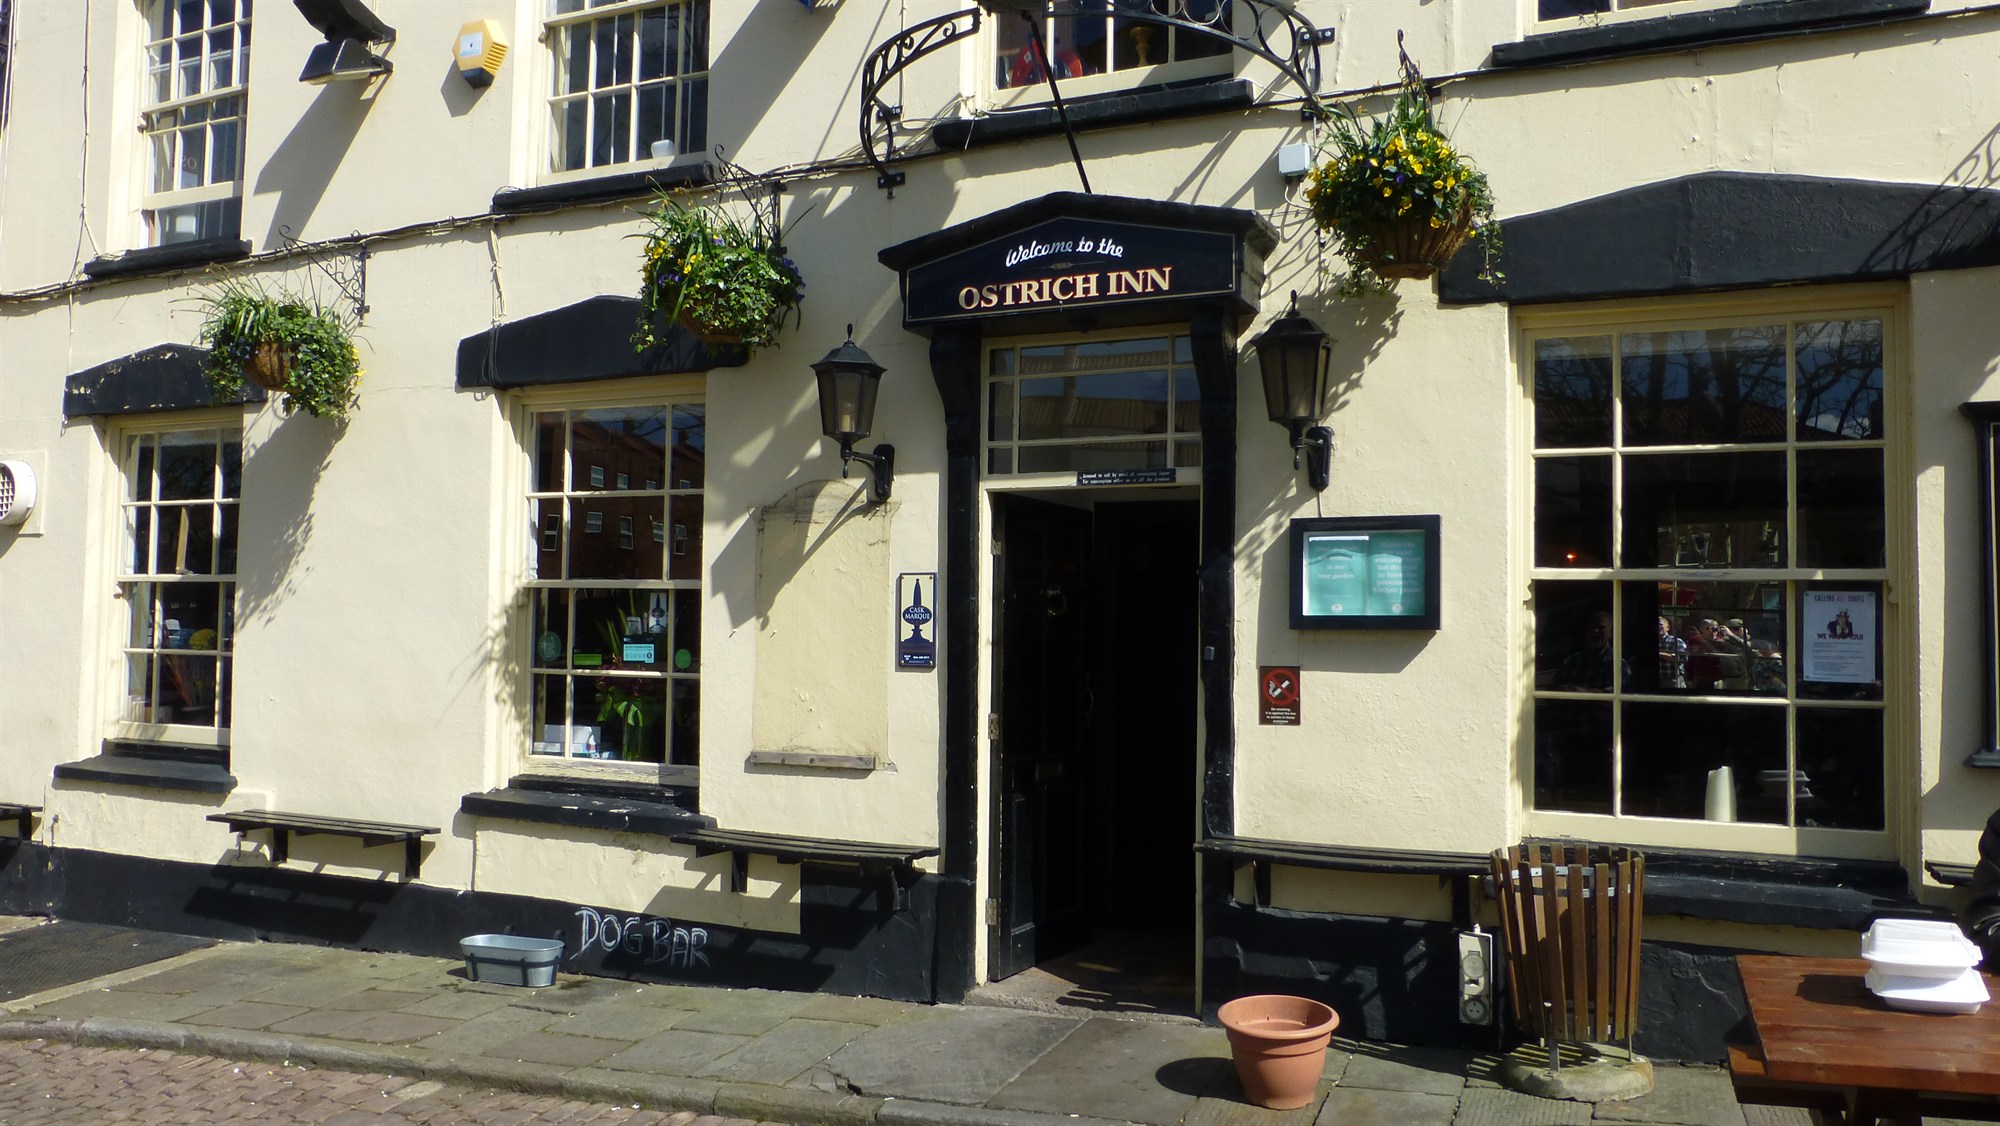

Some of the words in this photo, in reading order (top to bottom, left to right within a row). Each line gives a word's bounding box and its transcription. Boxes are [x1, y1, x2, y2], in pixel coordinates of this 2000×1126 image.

[1006, 240, 1073, 267] Welcome
[1076, 236, 1093, 253] to
[1096, 238, 1123, 258] the
[958, 273, 1099, 311] OSTRICH
[1106, 267, 1171, 297] INN
[570, 907, 643, 960] DOG
[644, 917, 710, 967] BAR
